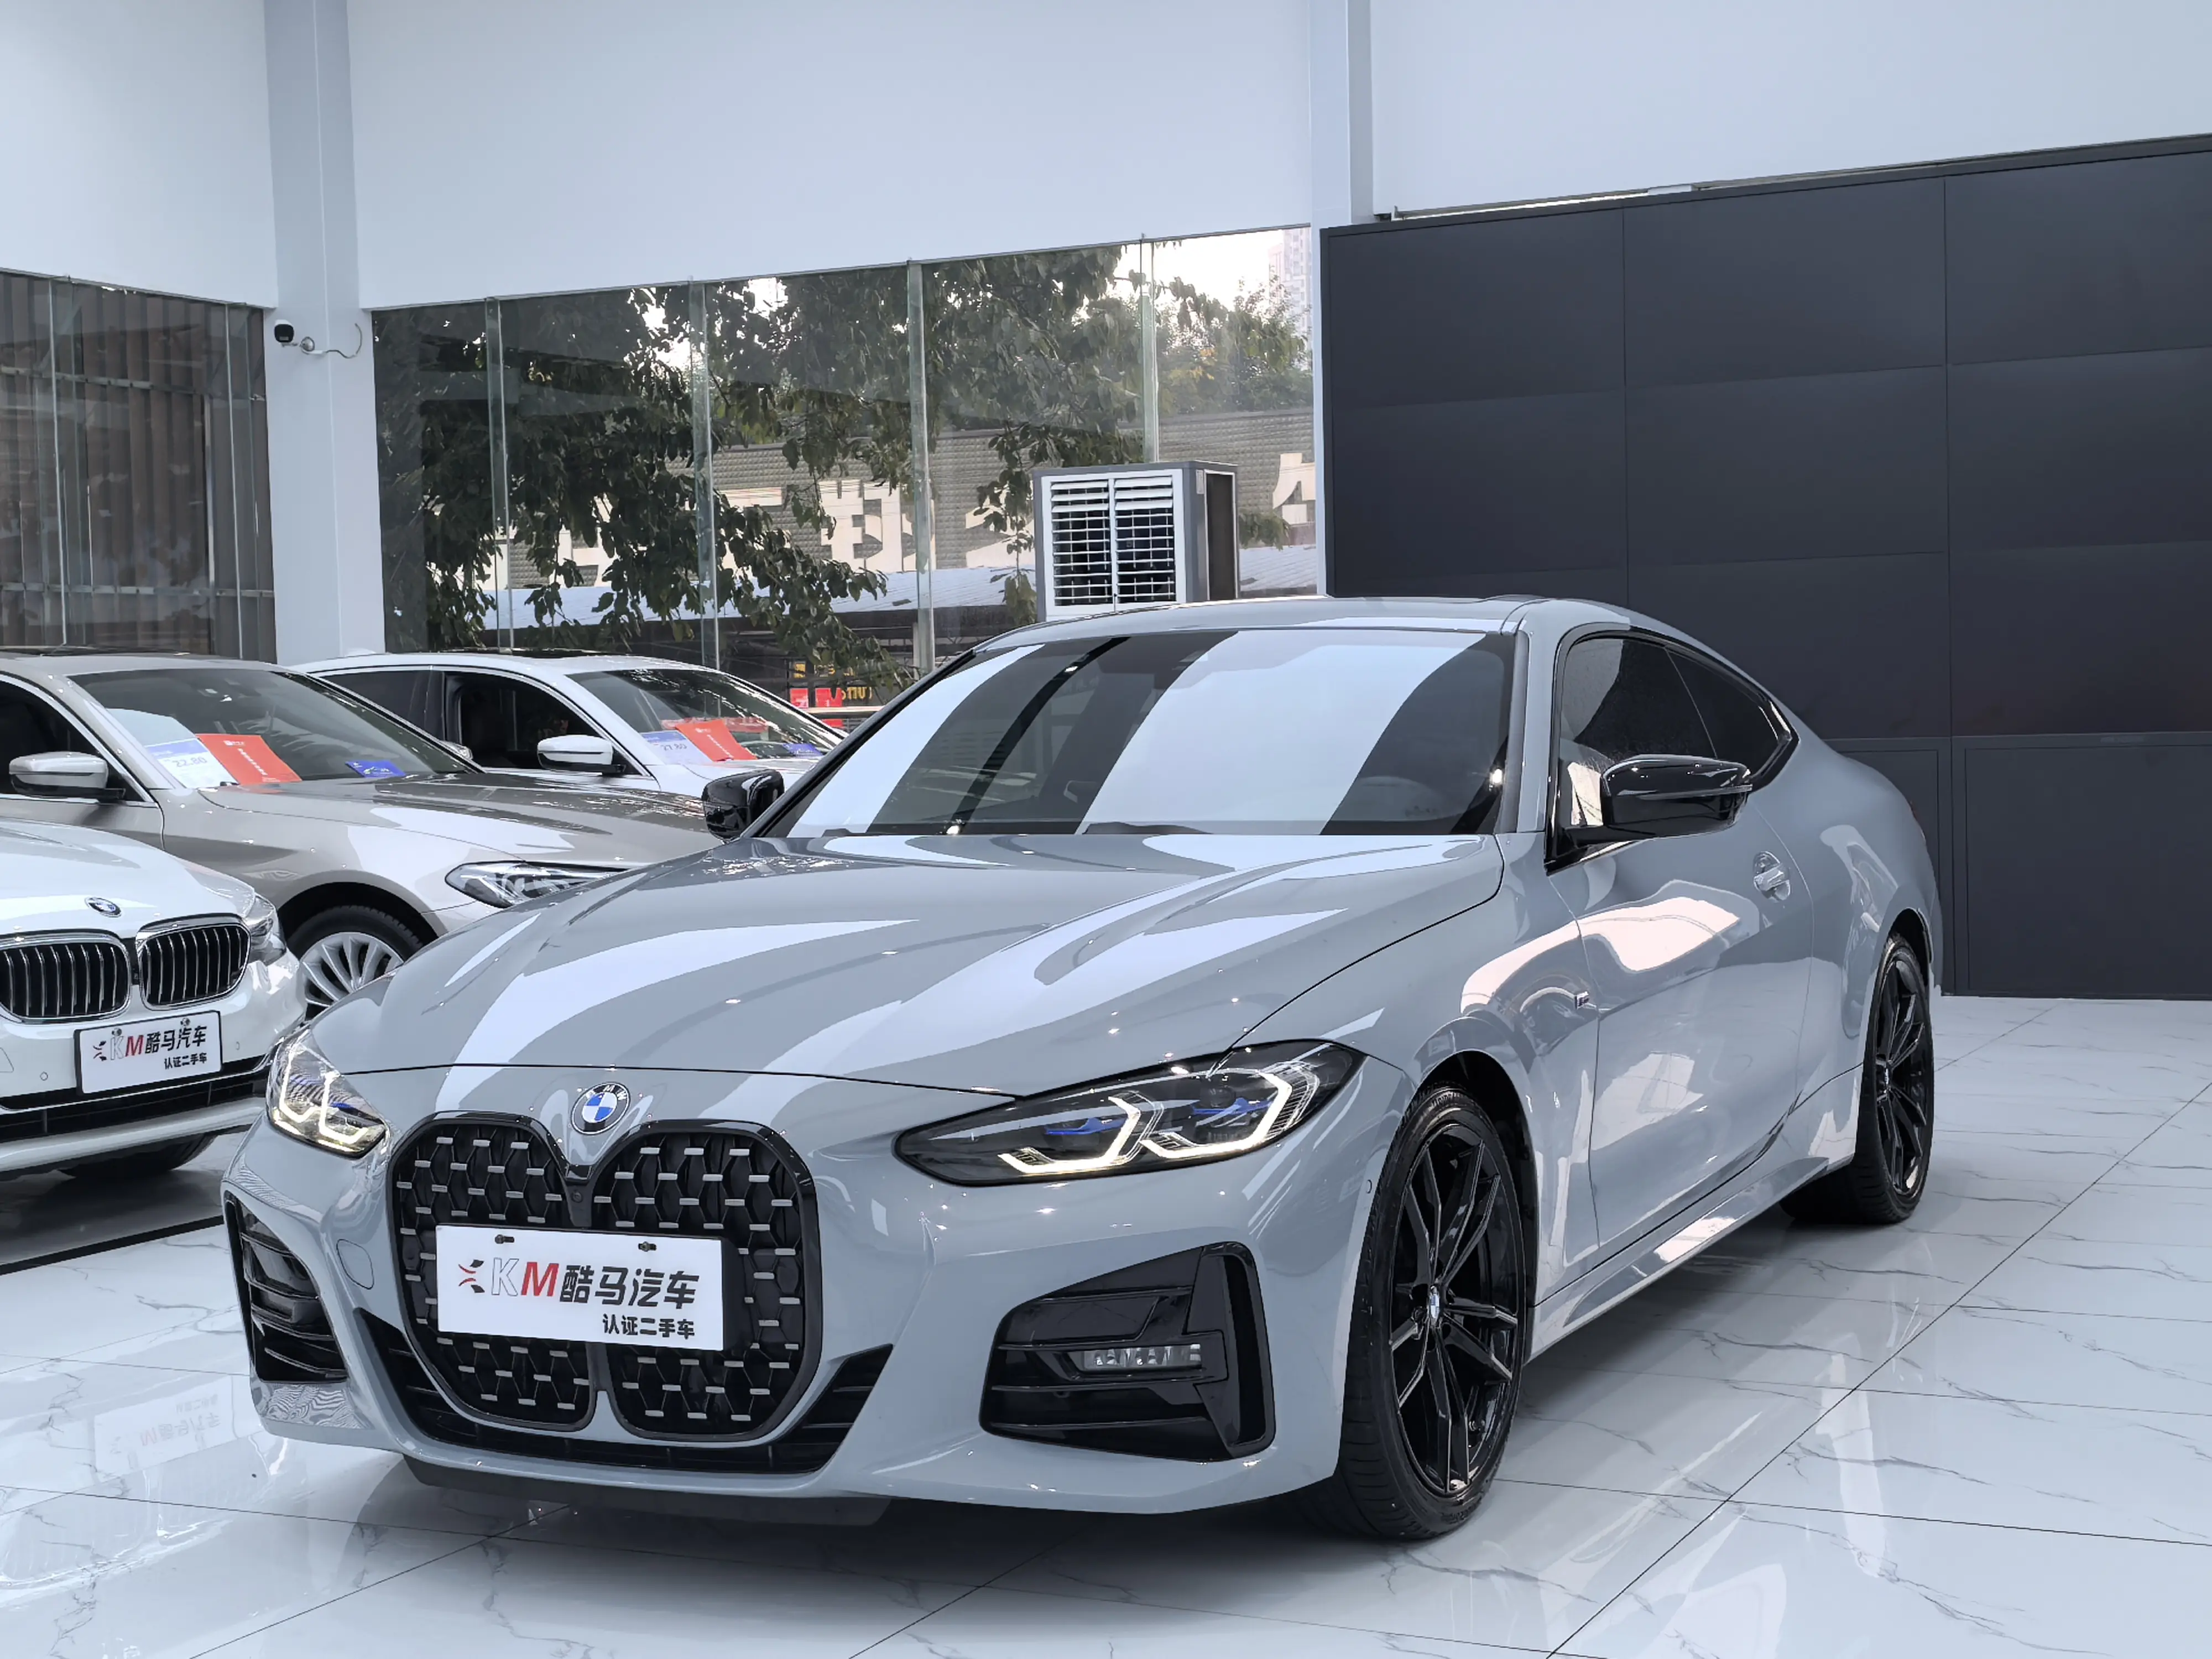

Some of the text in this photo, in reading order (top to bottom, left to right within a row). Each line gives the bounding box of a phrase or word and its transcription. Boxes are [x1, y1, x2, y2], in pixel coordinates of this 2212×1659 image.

[164, 1052, 207, 1070] 认证二手车
[585, 1084, 627, 1101] BMW
[602, 1313, 696, 1340] 认证二手车
